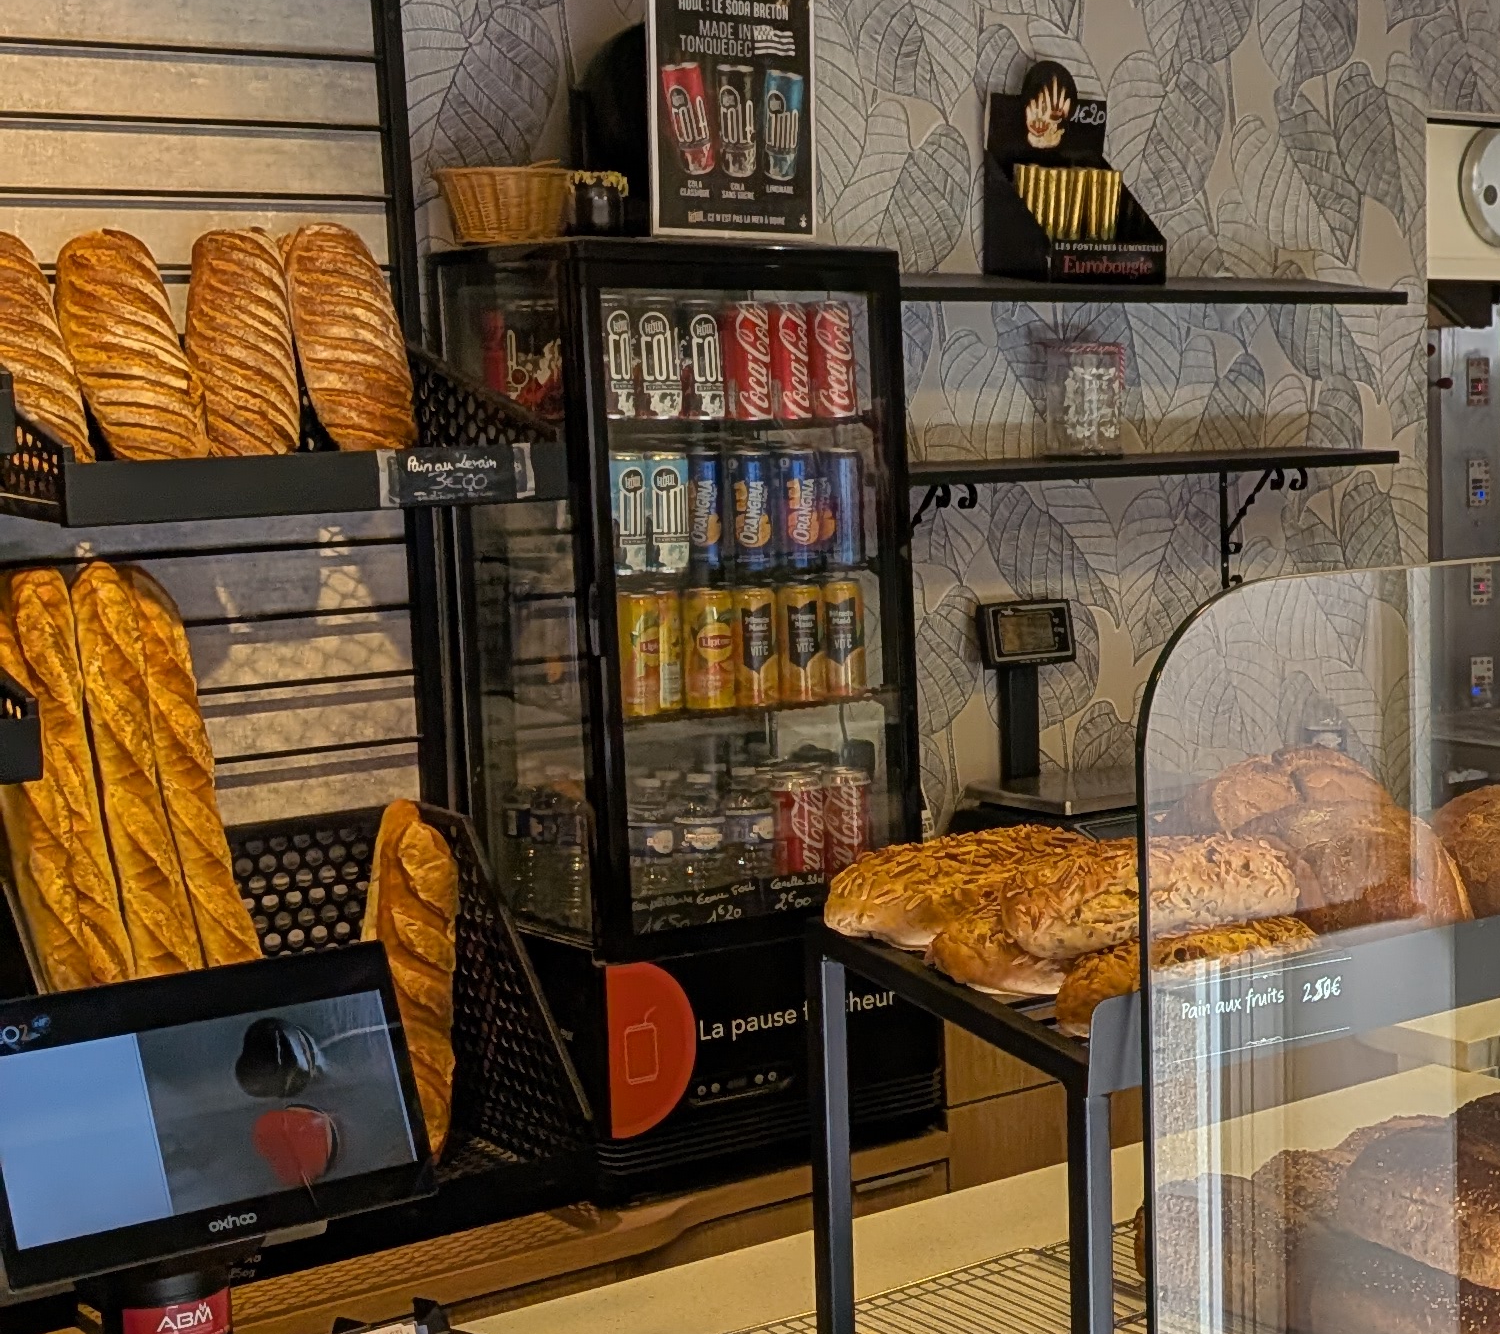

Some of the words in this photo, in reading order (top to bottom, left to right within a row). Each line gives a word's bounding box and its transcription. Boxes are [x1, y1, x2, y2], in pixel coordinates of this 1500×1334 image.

[753, 1, 789, 21] BRETON
[699, 19, 735, 39] MADE
[738, 23, 752, 41] IN
[679, 34, 753, 58] TONQUEDEC
[735, 301, 774, 420] Coca-Cola
[815, 301, 857, 417] Coca-Cola
[407, 455, 433, 473] Pain
[434, 460, 454, 472] au
[740, 480, 765, 544] ORANGINA
[792, 478, 815, 542] ORANGINA
[1181, 1001, 1211, 1019] Pain
[1214, 997, 1242, 1014] aux
[1244, 985, 1285, 1014] fruits
[699, 1019, 724, 1042] La
[731, 1009, 798, 1046] pause
[802, 990, 896, 1023] fheur
[208, 1212, 257, 1233] oxhoo
[156, 1304, 214, 1333] ABM
